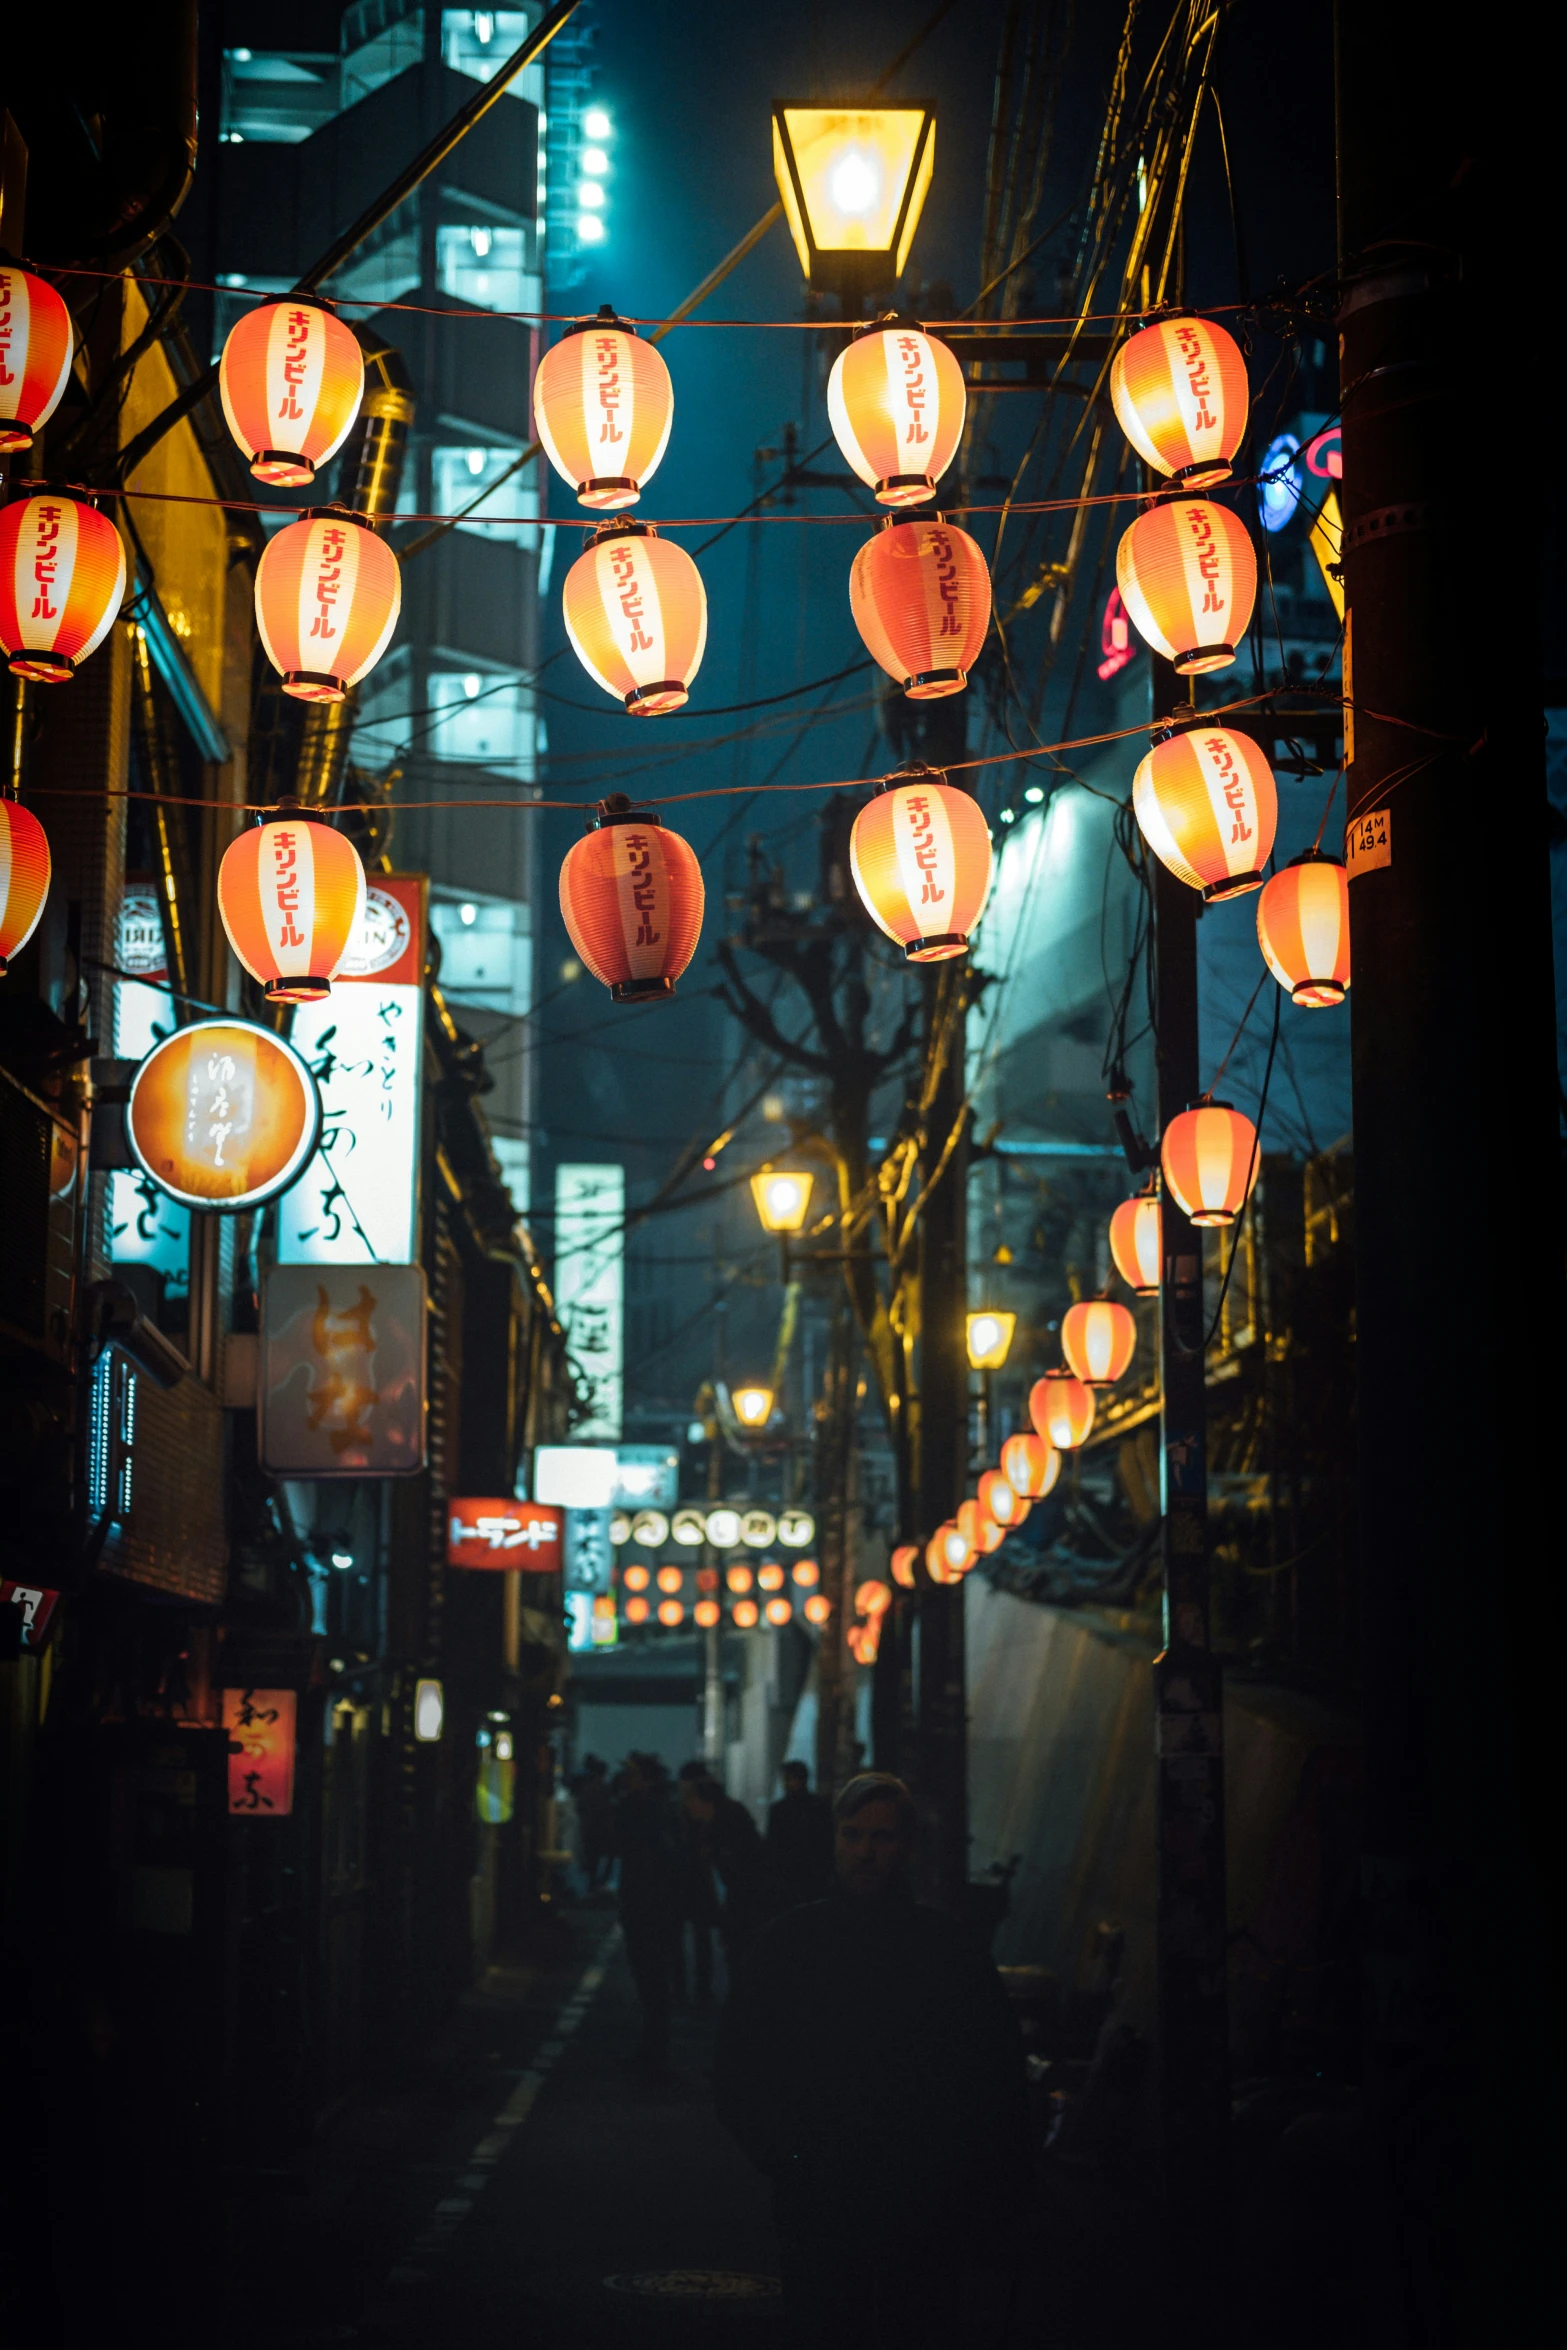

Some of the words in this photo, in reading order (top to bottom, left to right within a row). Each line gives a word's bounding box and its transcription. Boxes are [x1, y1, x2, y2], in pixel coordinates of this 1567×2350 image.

[278, 310, 310, 420] キリンビール
[594, 336, 623, 443] キリンビール
[898, 336, 928, 444] キリンビール
[1175, 327, 1217, 431] キリンビール
[30, 505, 63, 621] キリンビール
[311, 527, 346, 638] キリンビール
[610, 545, 654, 653] キリンビール
[930, 529, 962, 637] キリンビール
[1186, 508, 1224, 613] キリンビール
[1206, 738, 1252, 843] キリンビール
[1359, 831, 1387, 851] 49.4
[274, 832, 304, 948] キリンビール
[625, 833, 661, 947] キリンビール
[905, 795, 945, 905] キリンビール
